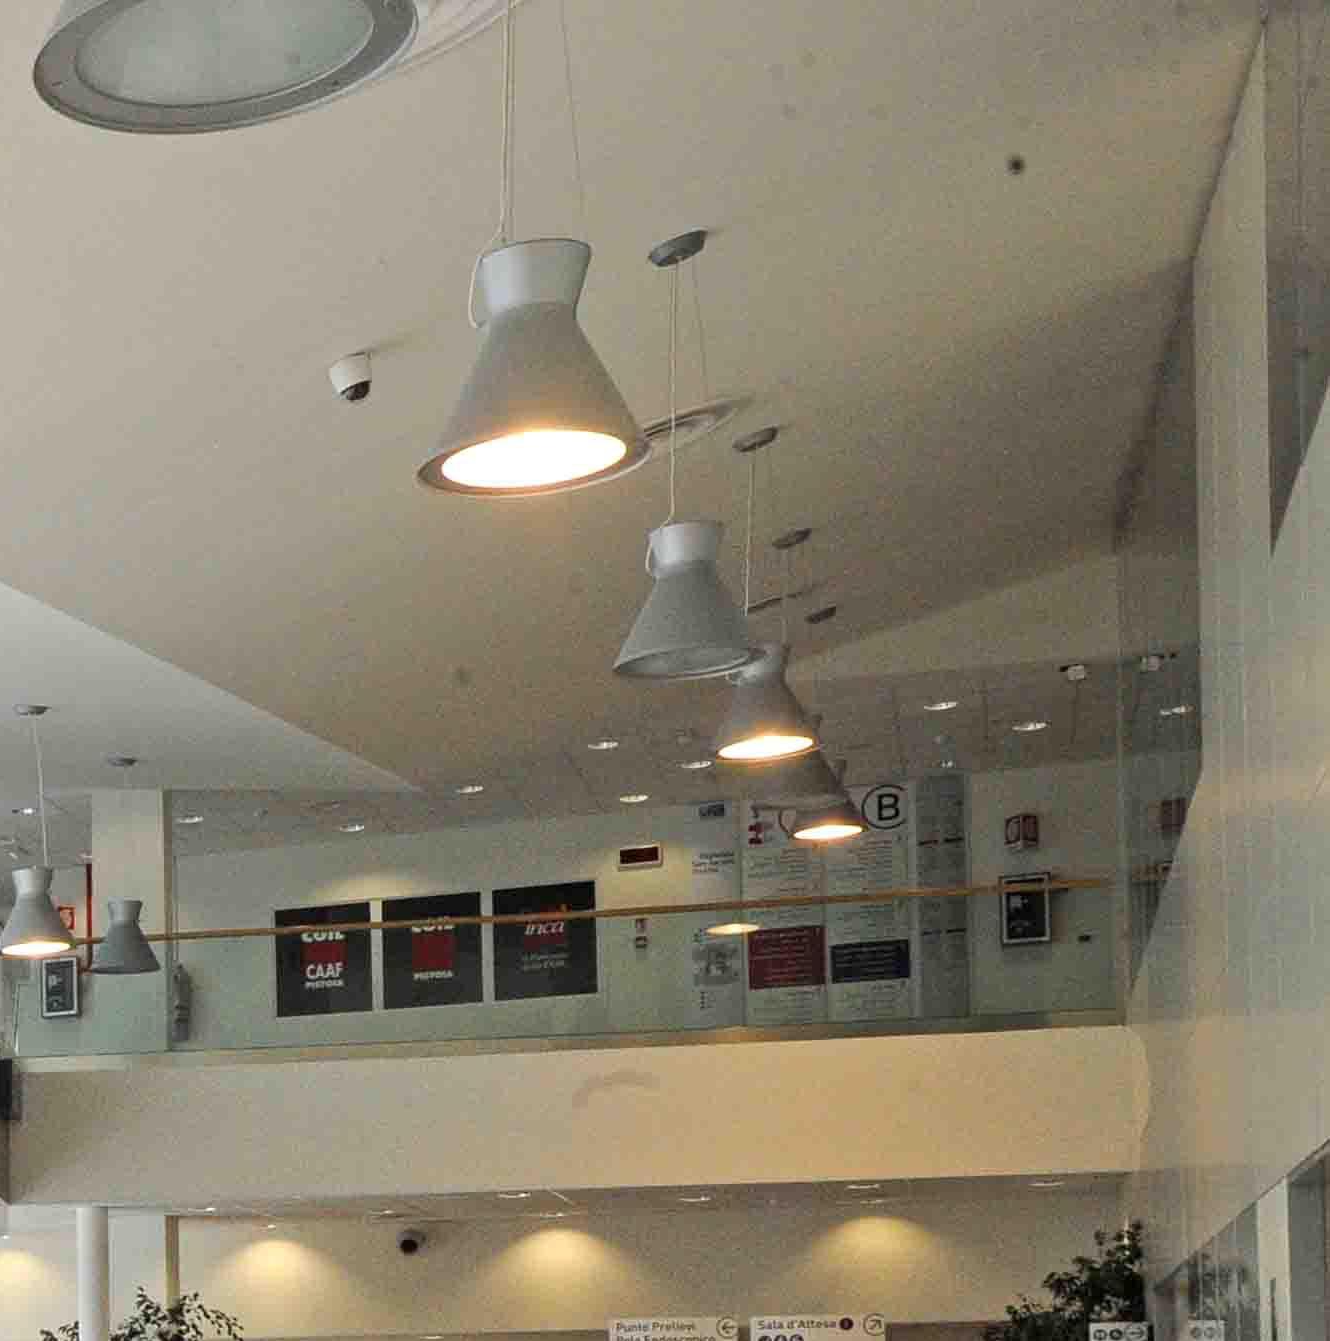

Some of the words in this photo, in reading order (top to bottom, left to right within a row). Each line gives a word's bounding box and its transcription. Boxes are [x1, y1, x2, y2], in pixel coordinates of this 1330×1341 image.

[878, 793, 900, 821] B
[306, 962, 344, 980] CAAF
[757, 1319, 784, 1330] Sala
